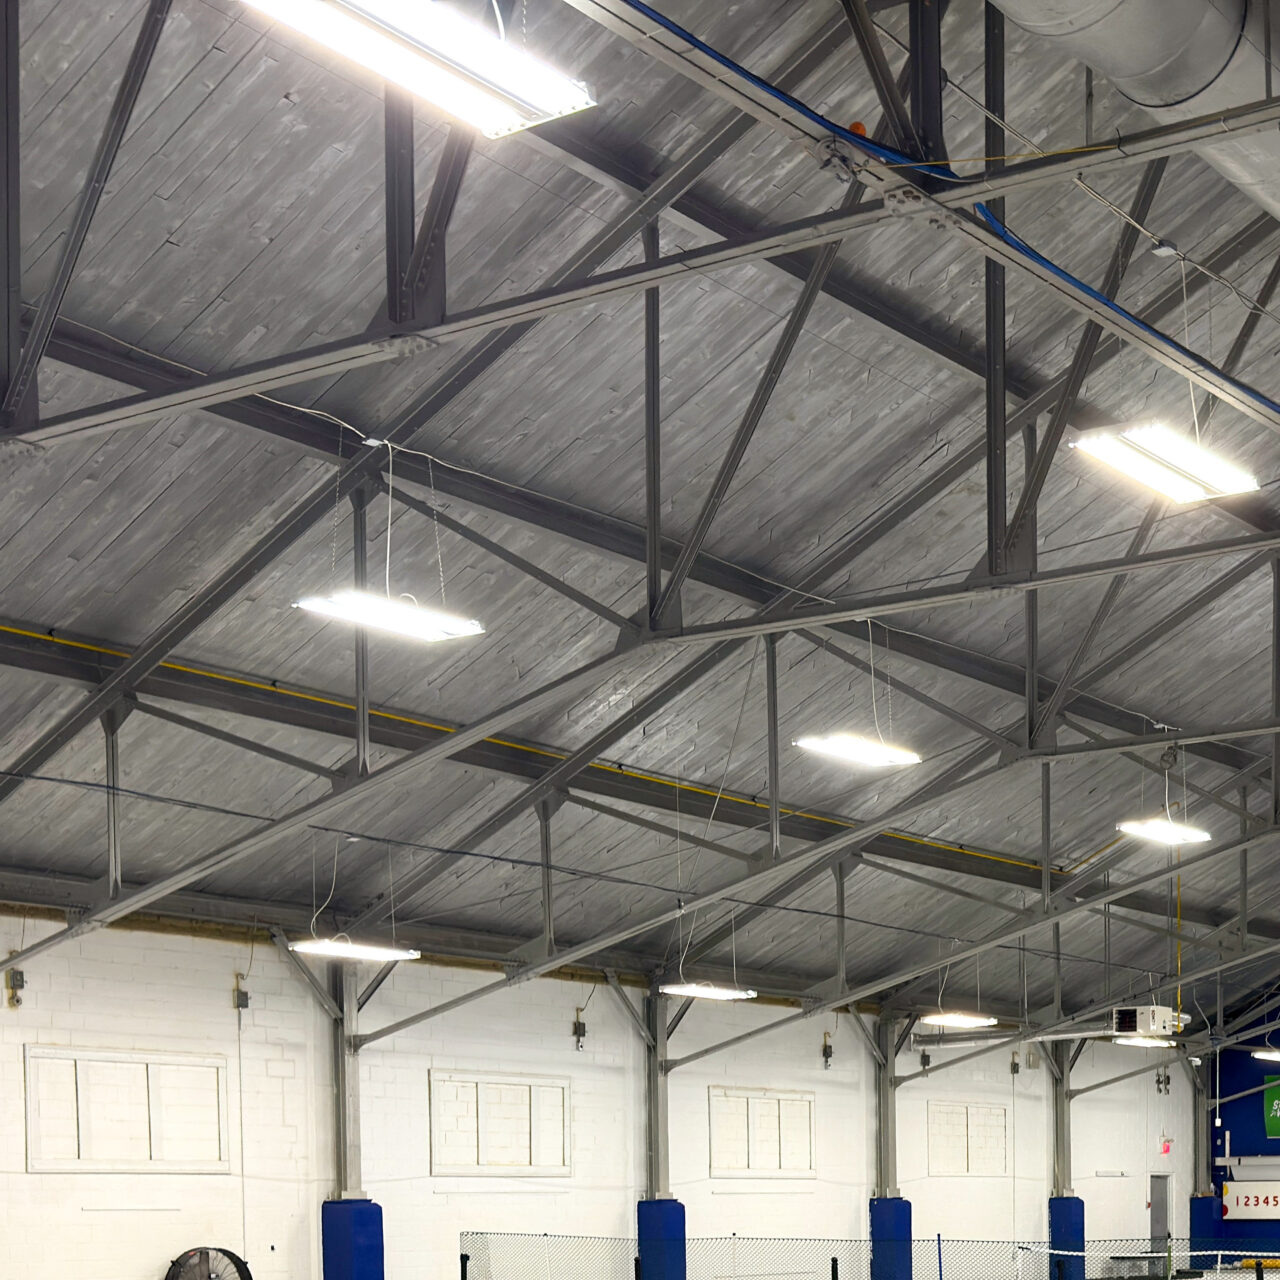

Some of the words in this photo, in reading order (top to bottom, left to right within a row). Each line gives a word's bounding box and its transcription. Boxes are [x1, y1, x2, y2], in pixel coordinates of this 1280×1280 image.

[1244, 1196, 1251, 1206] 2
[1254, 1196, 1260, 1206] 3
[1263, 1196, 1270, 1206] 4
[1273, 1196, 1278, 1206] 5
